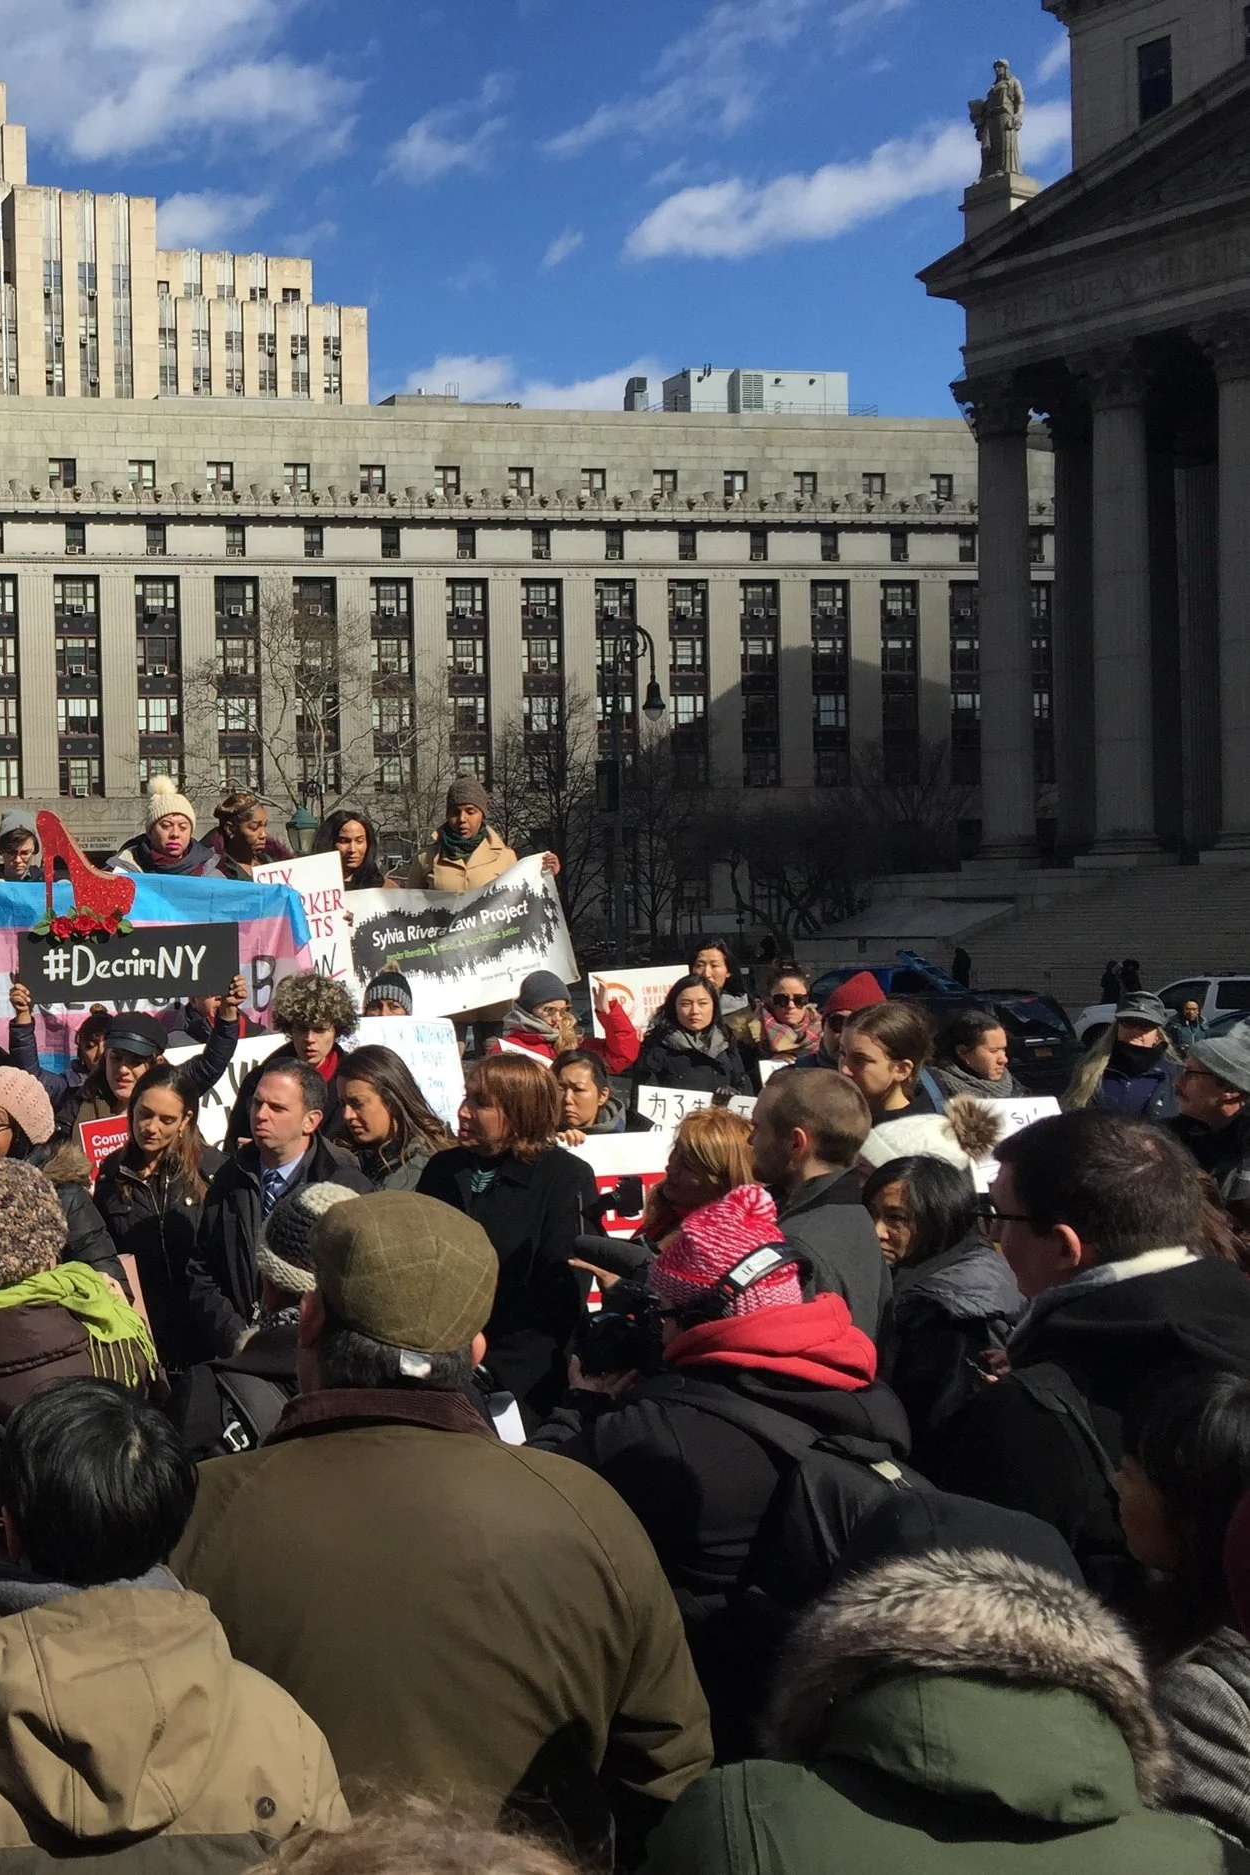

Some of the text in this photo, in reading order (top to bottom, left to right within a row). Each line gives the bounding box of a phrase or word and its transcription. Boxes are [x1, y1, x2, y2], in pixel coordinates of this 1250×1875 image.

[372, 899, 529, 951] Sylvia Rivera Law Project
[42, 944, 206, 987] #DecrimNY
